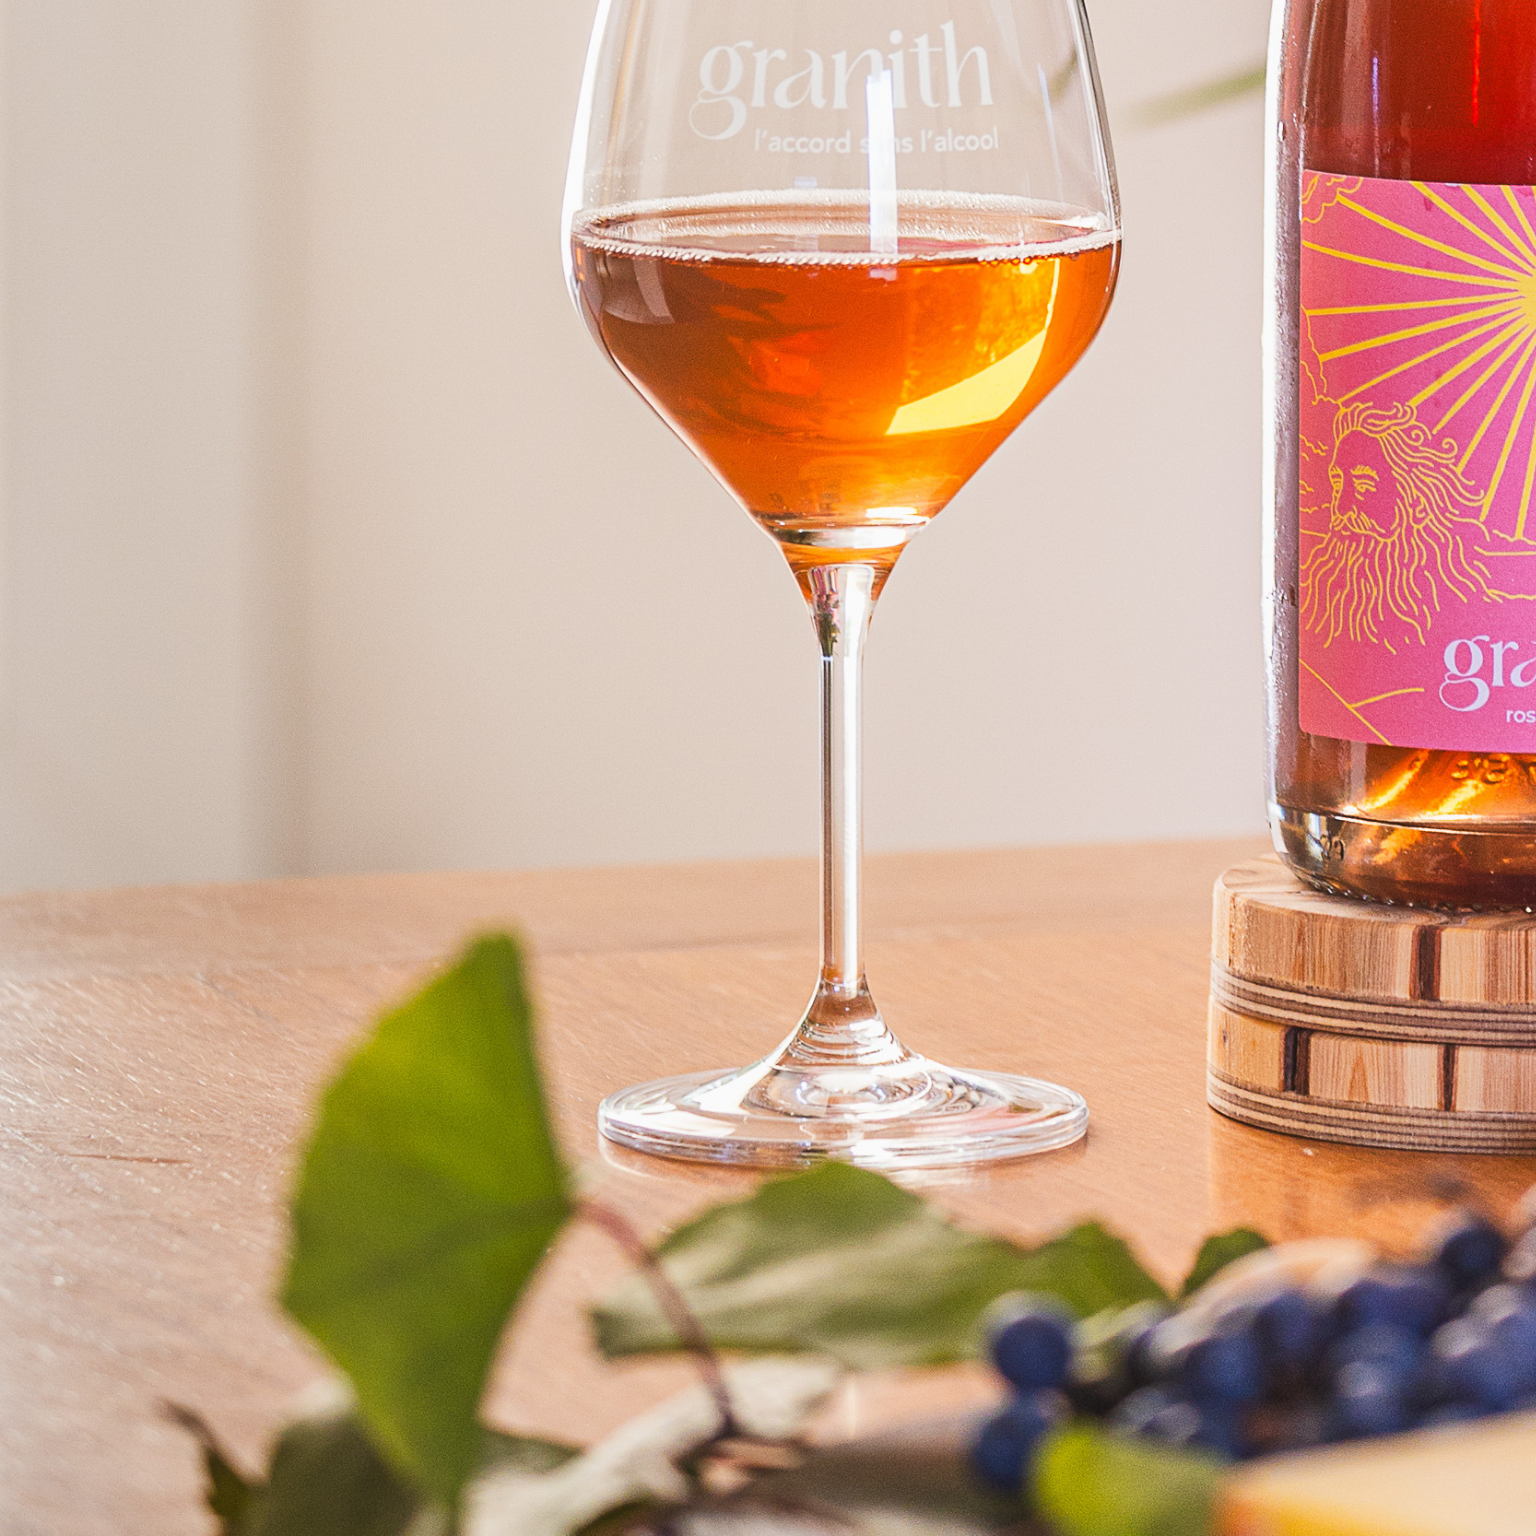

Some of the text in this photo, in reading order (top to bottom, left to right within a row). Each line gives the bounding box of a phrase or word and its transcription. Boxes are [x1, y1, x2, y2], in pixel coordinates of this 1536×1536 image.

[688, 19, 994, 141] granith
[754, 126, 1000, 154] l'accord sns l'alcool
